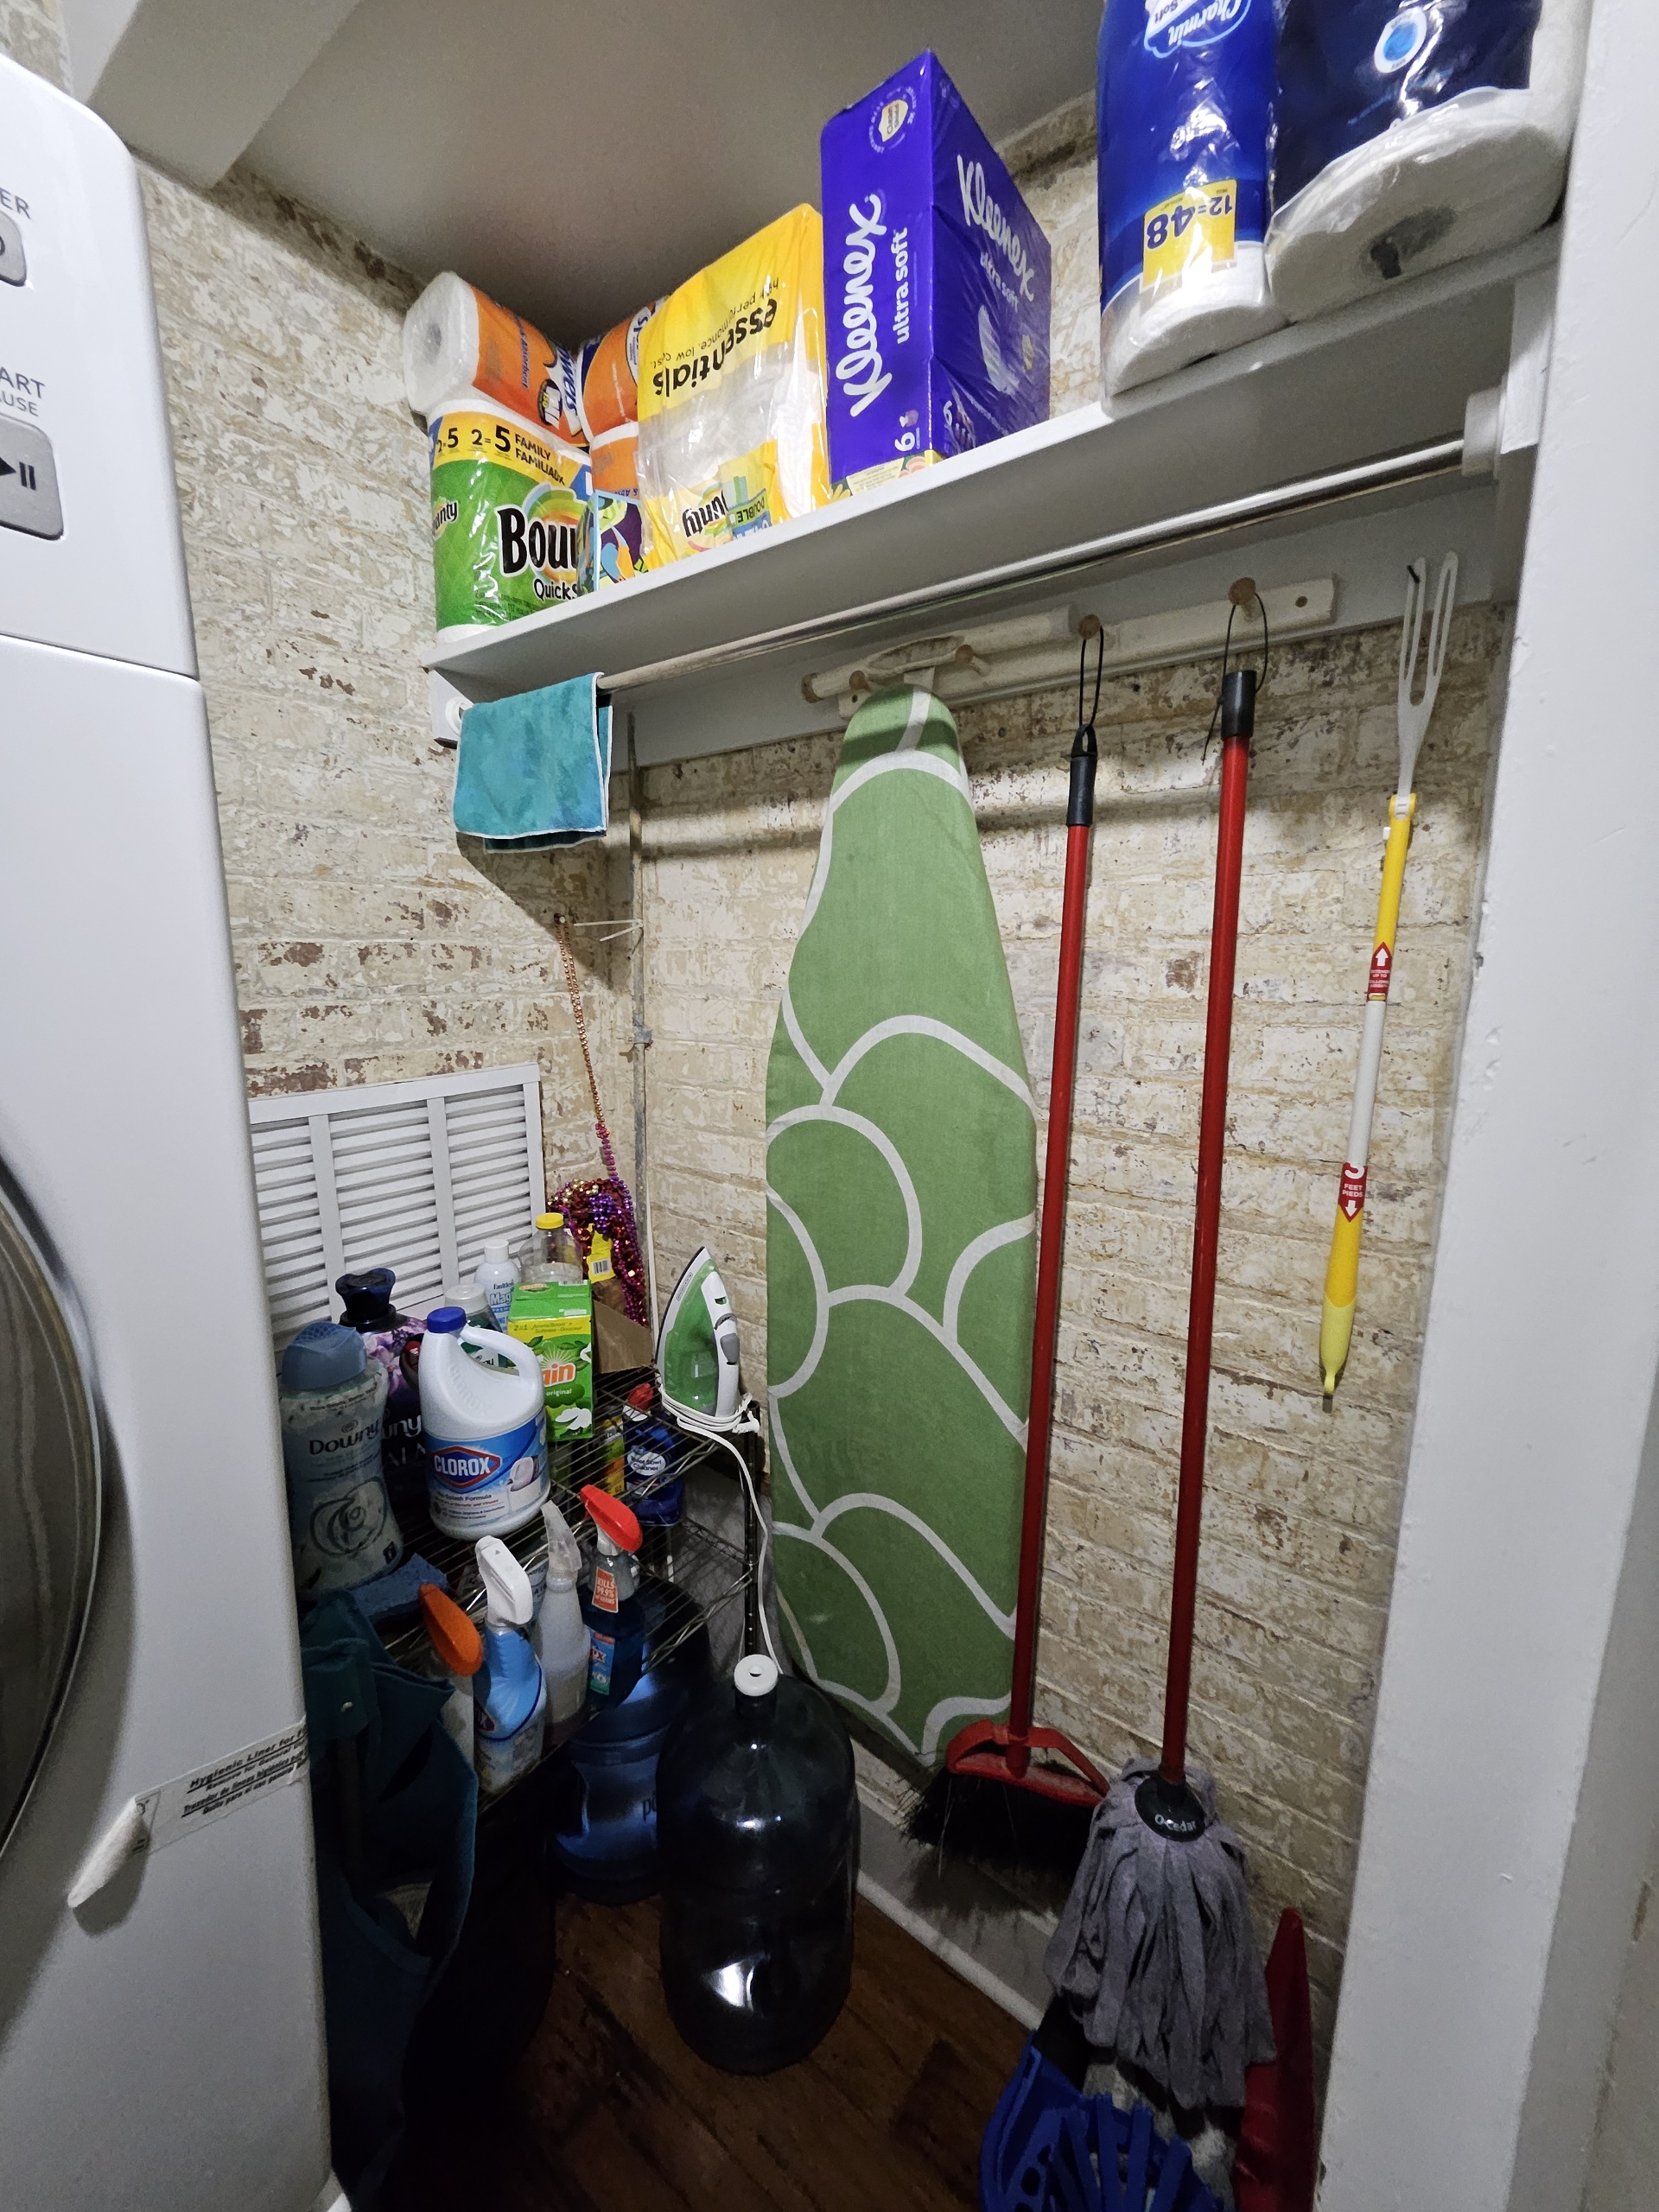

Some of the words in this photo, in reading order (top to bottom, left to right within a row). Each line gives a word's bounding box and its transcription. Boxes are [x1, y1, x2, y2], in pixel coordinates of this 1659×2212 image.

[1168, 0, 1243, 46] Charmin
[957, 154, 1034, 302] Kleenex
[891, 226, 908, 282] soft
[836, 194, 893, 417] Kleenex
[893, 282, 910, 344] ultra
[653, 298, 778, 397] essentials
[677, 347, 695, 361] low
[0, 391, 39, 416] USE
[515, 433, 551, 461] FAMILY
[894, 431, 916, 452] 6
[433, 500, 458, 532] unty
[682, 490, 728, 537] unty
[1342, 1189, 1363, 1198] PIEDS
[546, 1388, 572, 1397] original
[309, 1419, 379, 1455] Downy
[434, 1455, 491, 1477] CLOROX
[596, 1586, 615, 1598] 99.9%
[597, 1577, 615, 1588] KILLS
[246, 1743, 276, 1761] Liner
[279, 1735, 295, 1746] for
